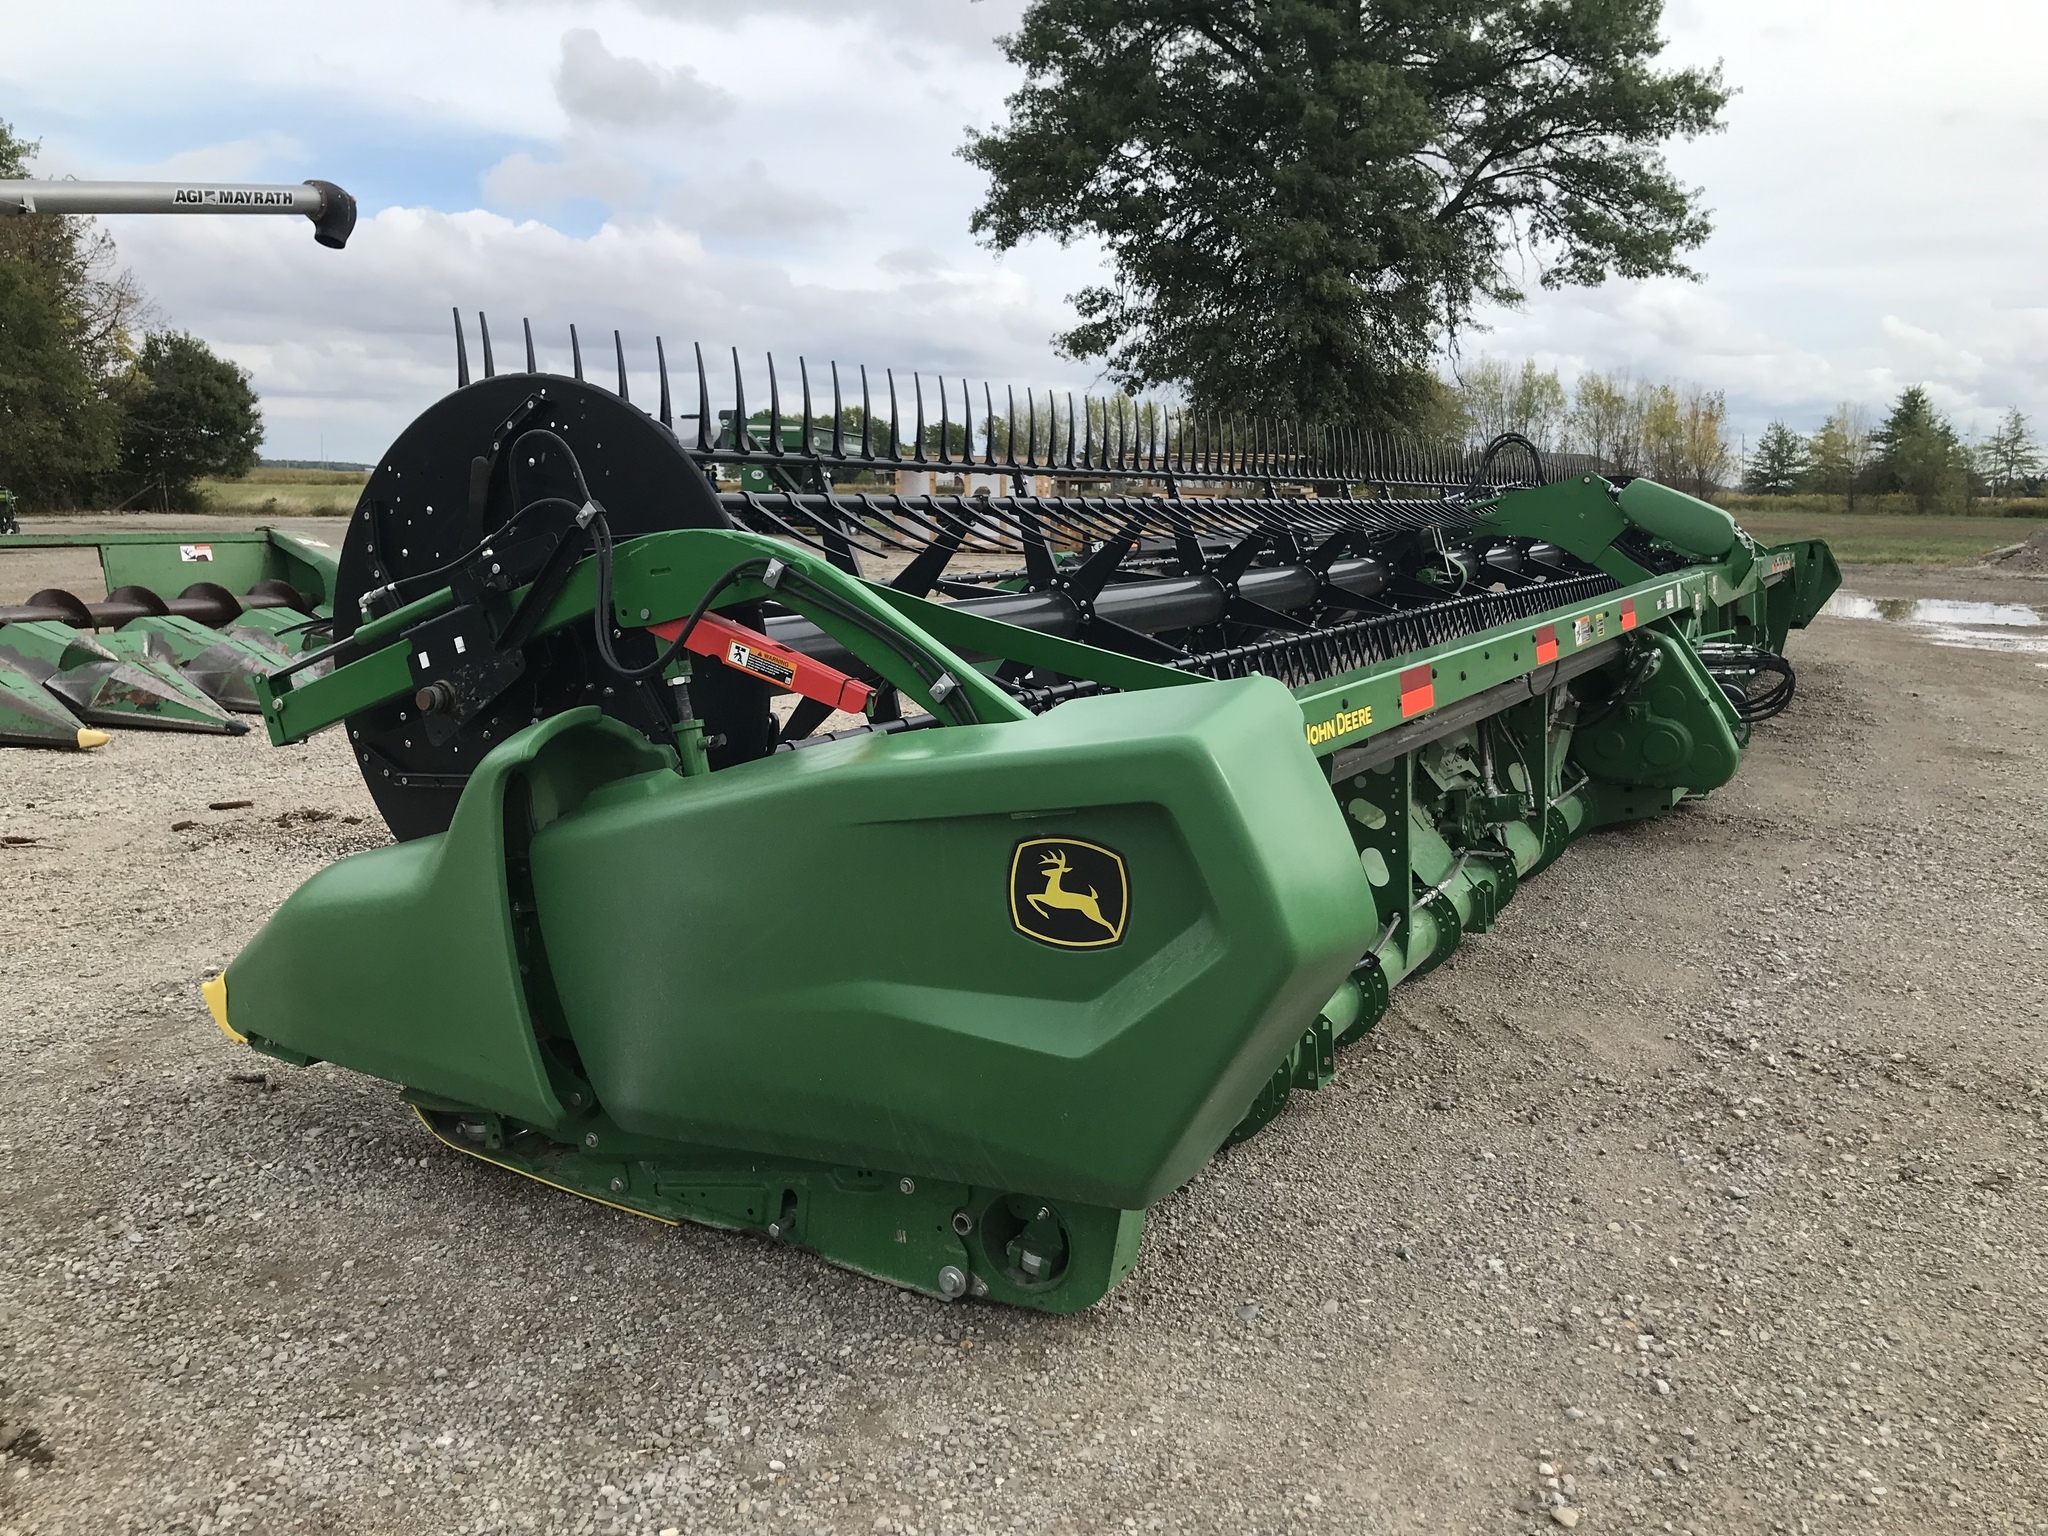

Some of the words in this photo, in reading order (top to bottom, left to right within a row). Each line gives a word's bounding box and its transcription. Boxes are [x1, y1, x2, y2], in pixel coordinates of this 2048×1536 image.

[175, 190, 203, 203] AGI
[219, 191, 293, 204] MAYRATH
[764, 653, 789, 667] WARNING
[1336, 705, 1373, 735] DEERE
